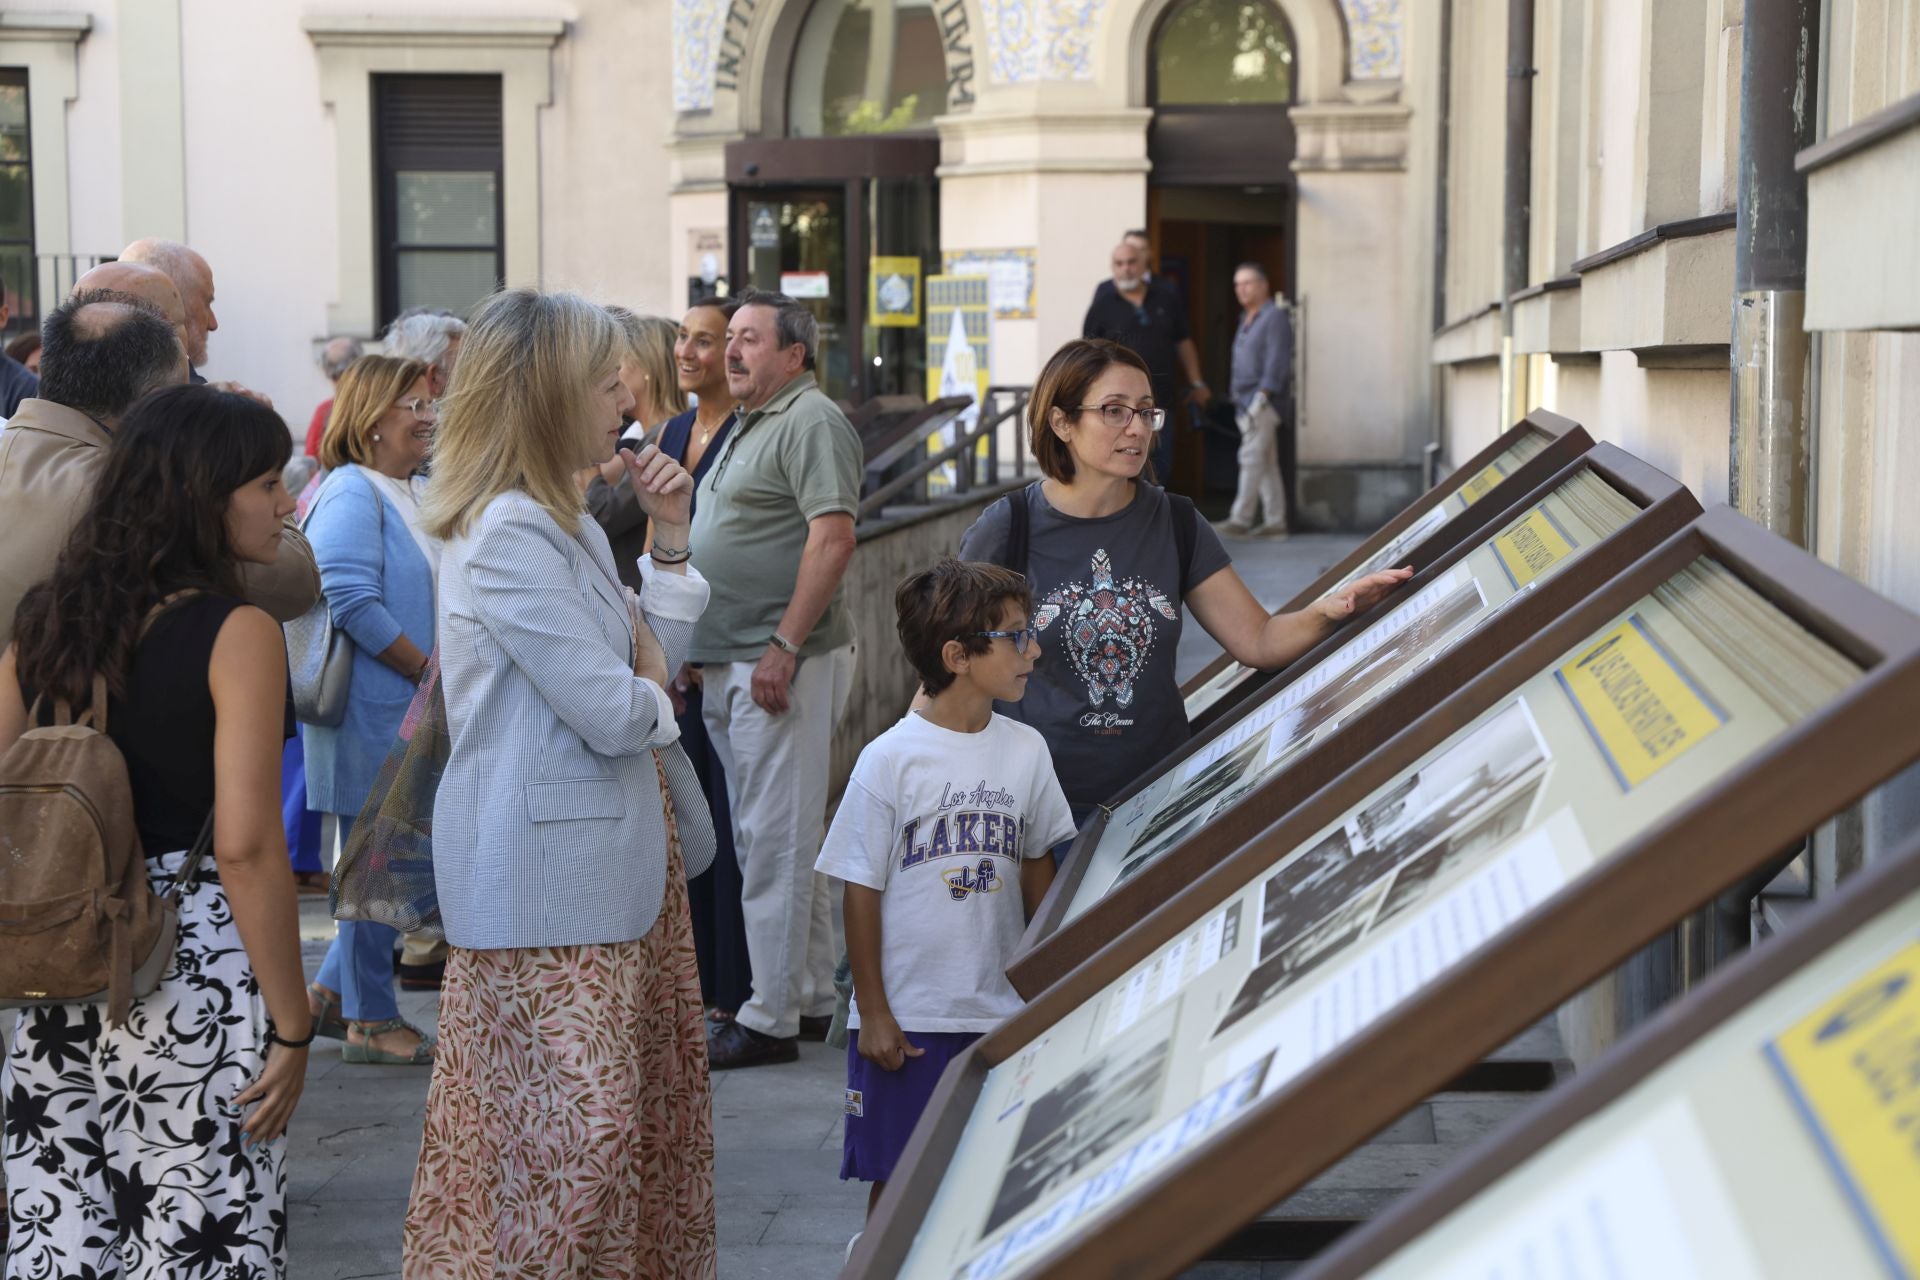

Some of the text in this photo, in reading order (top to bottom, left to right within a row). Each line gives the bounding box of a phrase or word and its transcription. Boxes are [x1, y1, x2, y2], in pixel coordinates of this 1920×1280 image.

[939, 0, 976, 106] LTVRA
[1080, 711, 1134, 728] The Ocean
[1101, 728, 1122, 737] calling
[938, 780, 1014, 810] Los Angeles
